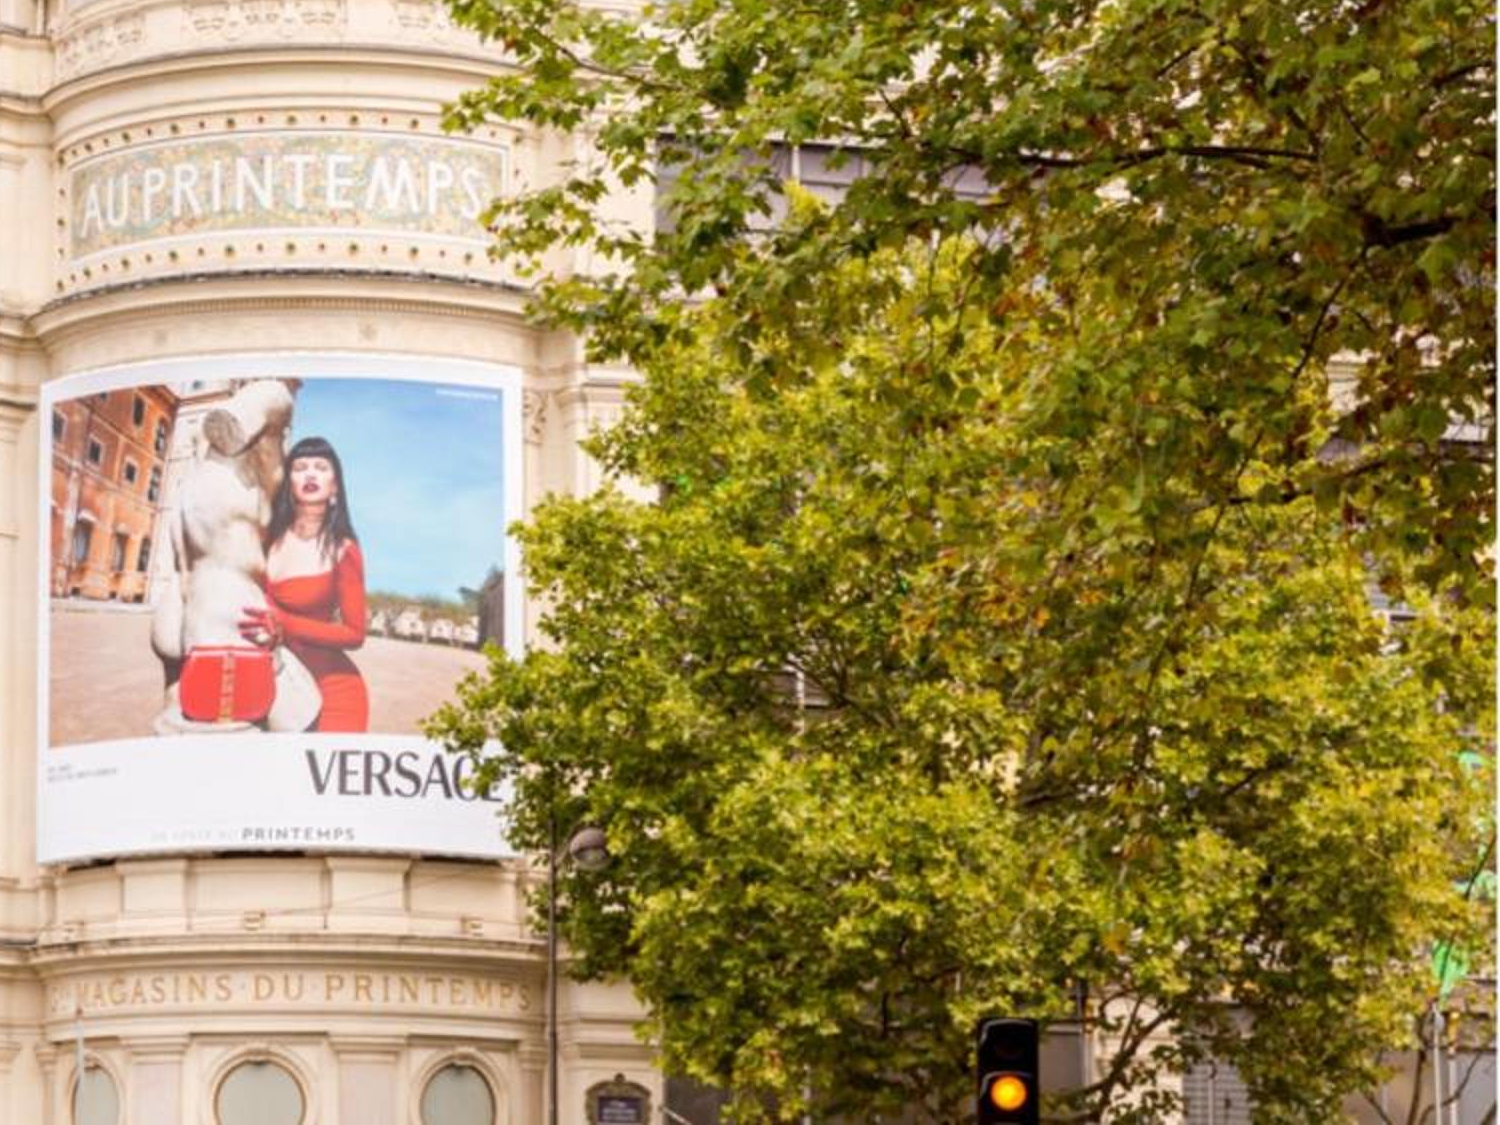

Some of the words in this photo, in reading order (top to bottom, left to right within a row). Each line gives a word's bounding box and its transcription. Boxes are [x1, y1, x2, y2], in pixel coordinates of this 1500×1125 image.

[81, 173, 130, 239] AU
[142, 154, 486, 222] PRINTEMPS
[241, 825, 356, 842] PRINTEMPS
[253, 974, 302, 1003] DU
[324, 973, 532, 1011] PRINTEMPS
